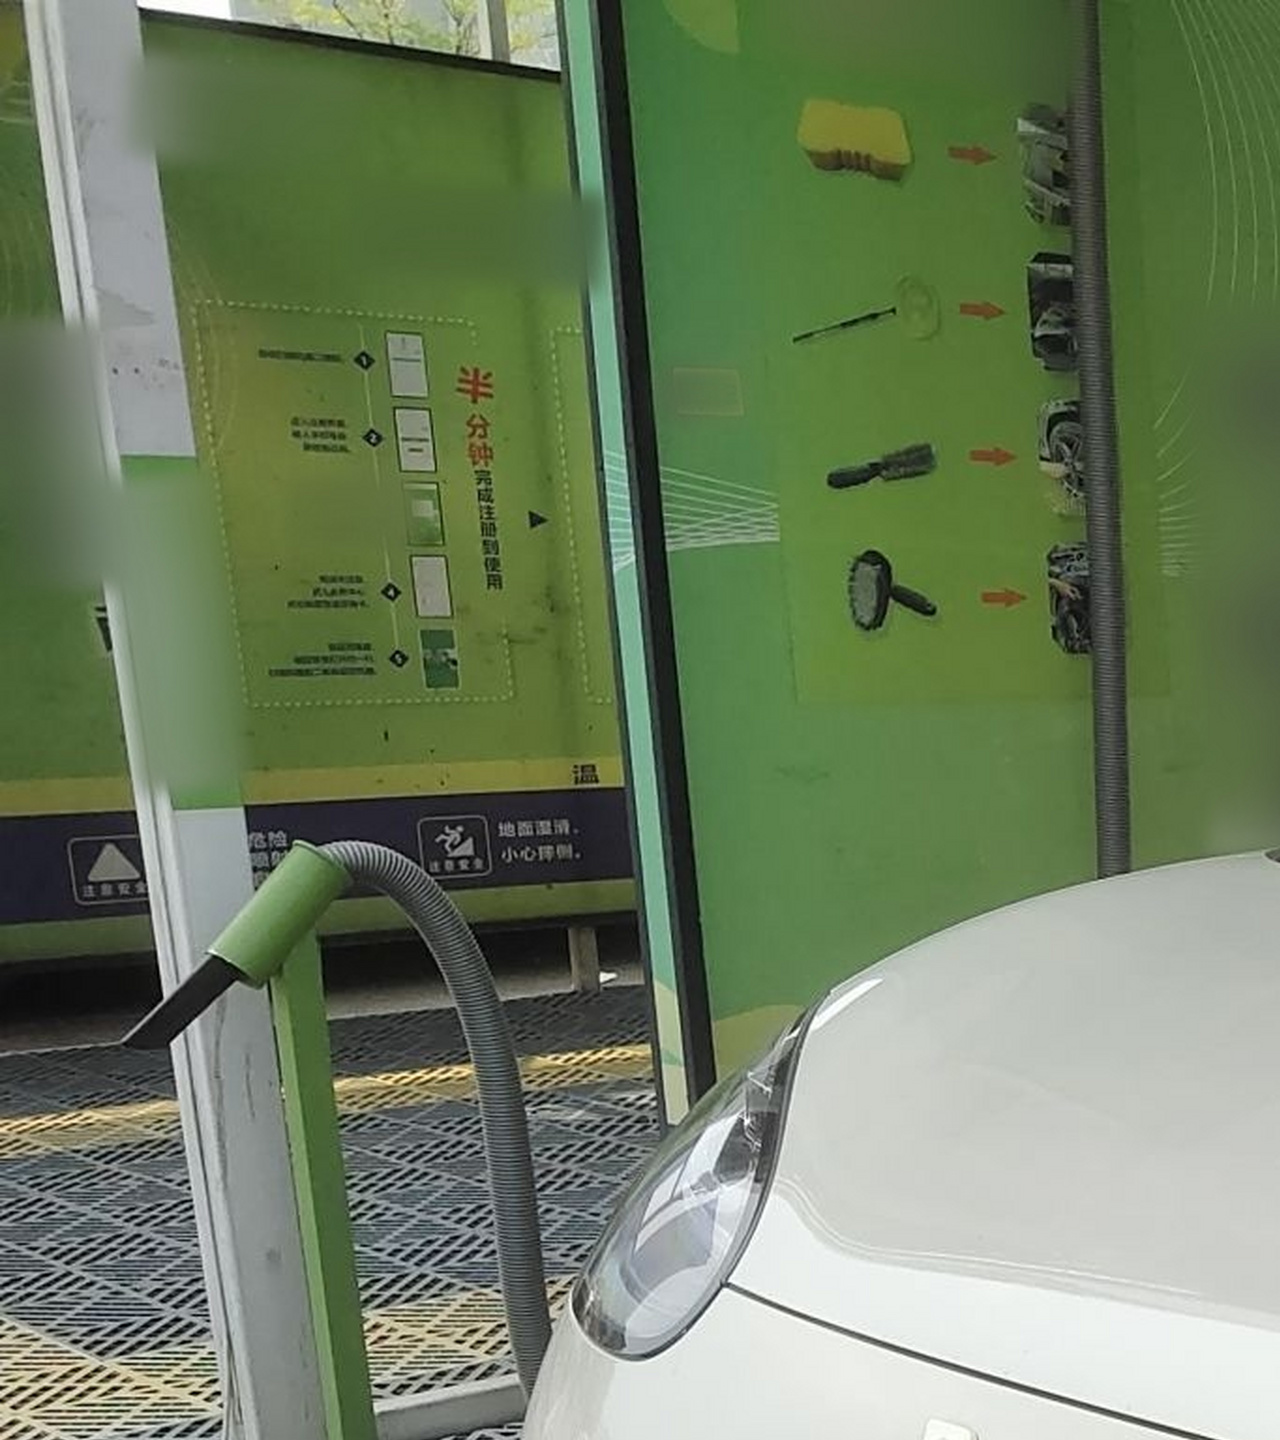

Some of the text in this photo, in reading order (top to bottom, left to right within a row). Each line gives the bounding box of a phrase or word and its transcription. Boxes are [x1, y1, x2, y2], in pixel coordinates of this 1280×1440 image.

[456, 366, 503, 590] 半分钟完成注册到使用
[572, 764, 600, 785] 温
